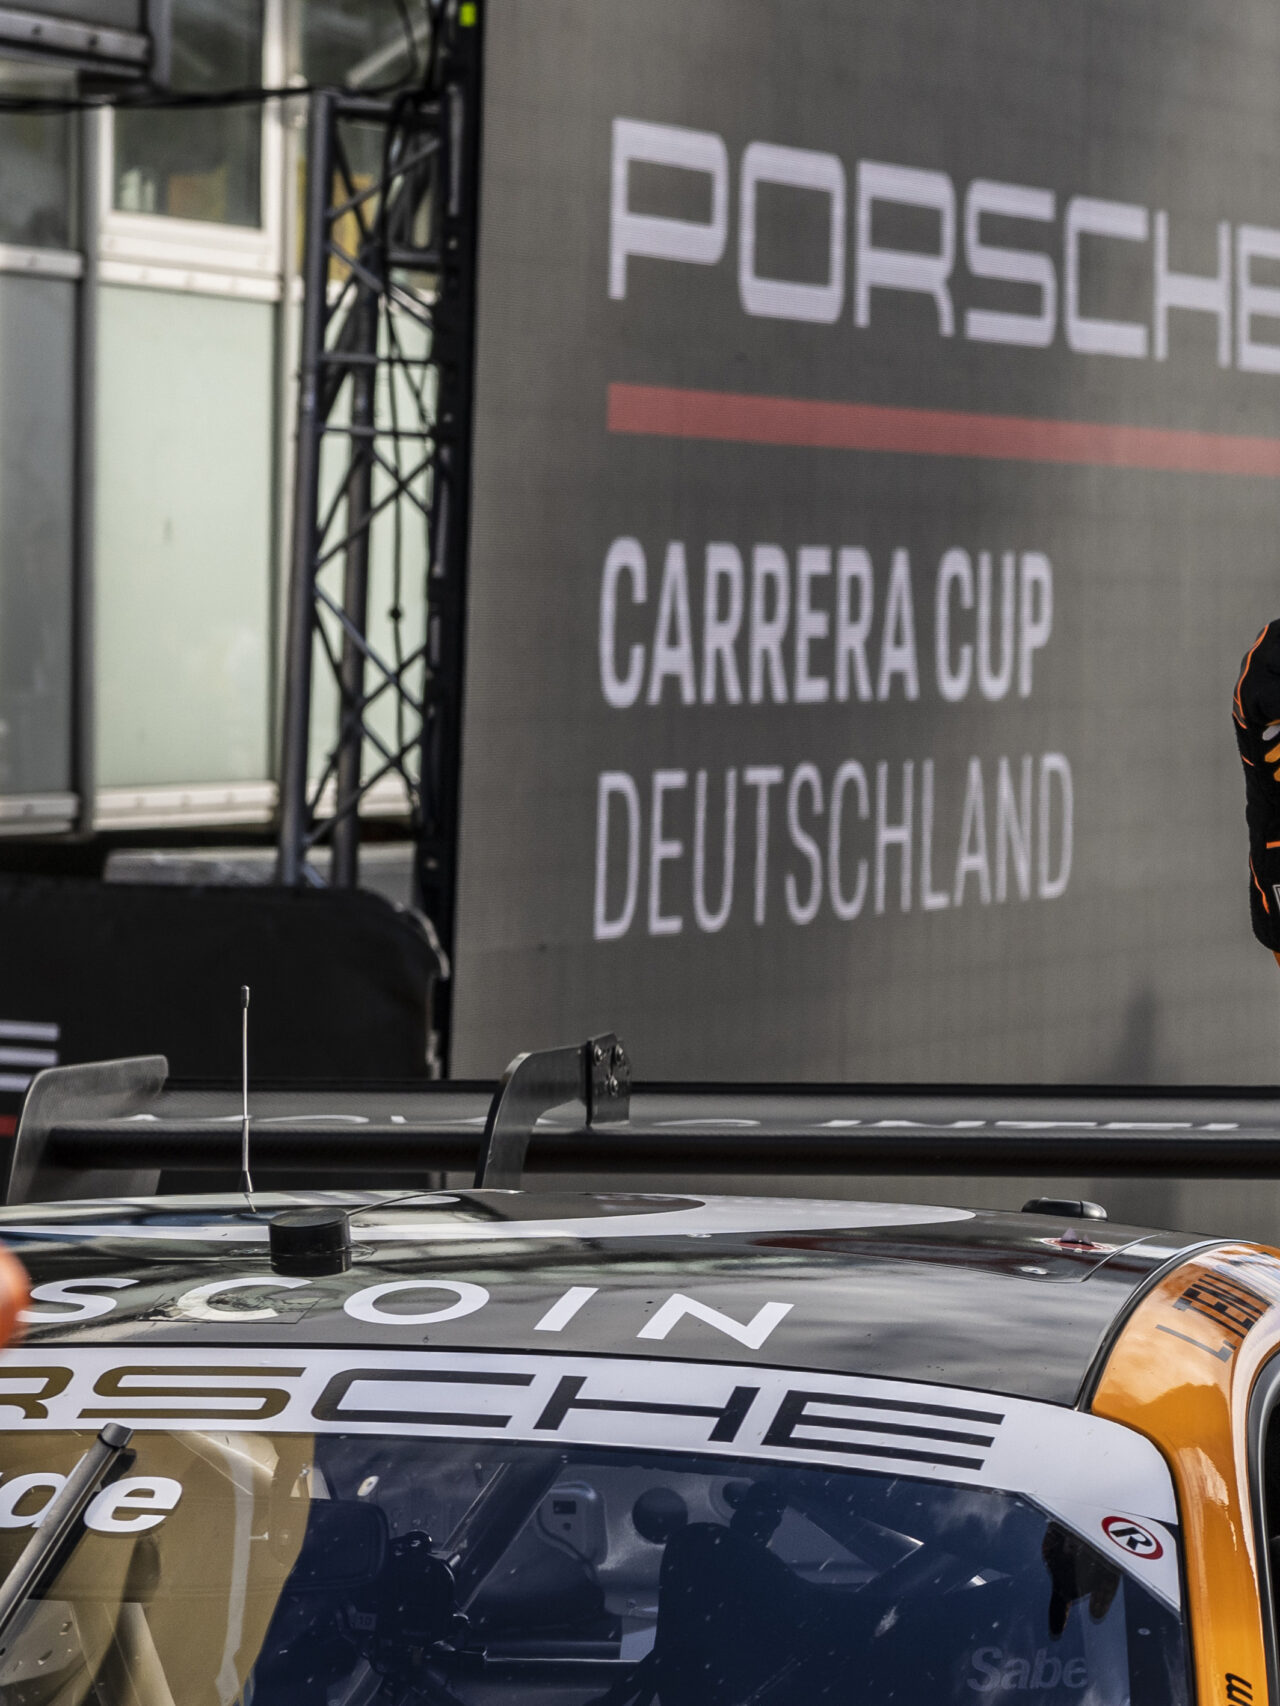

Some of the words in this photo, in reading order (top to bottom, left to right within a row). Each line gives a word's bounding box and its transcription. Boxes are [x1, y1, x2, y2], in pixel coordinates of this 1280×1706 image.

[601, 538, 919, 709] CARRERA
[935, 549, 1053, 702] CUP
[594, 754, 1074, 940] DEUTSCHLAND
[0, 1453, 183, 1533] de
